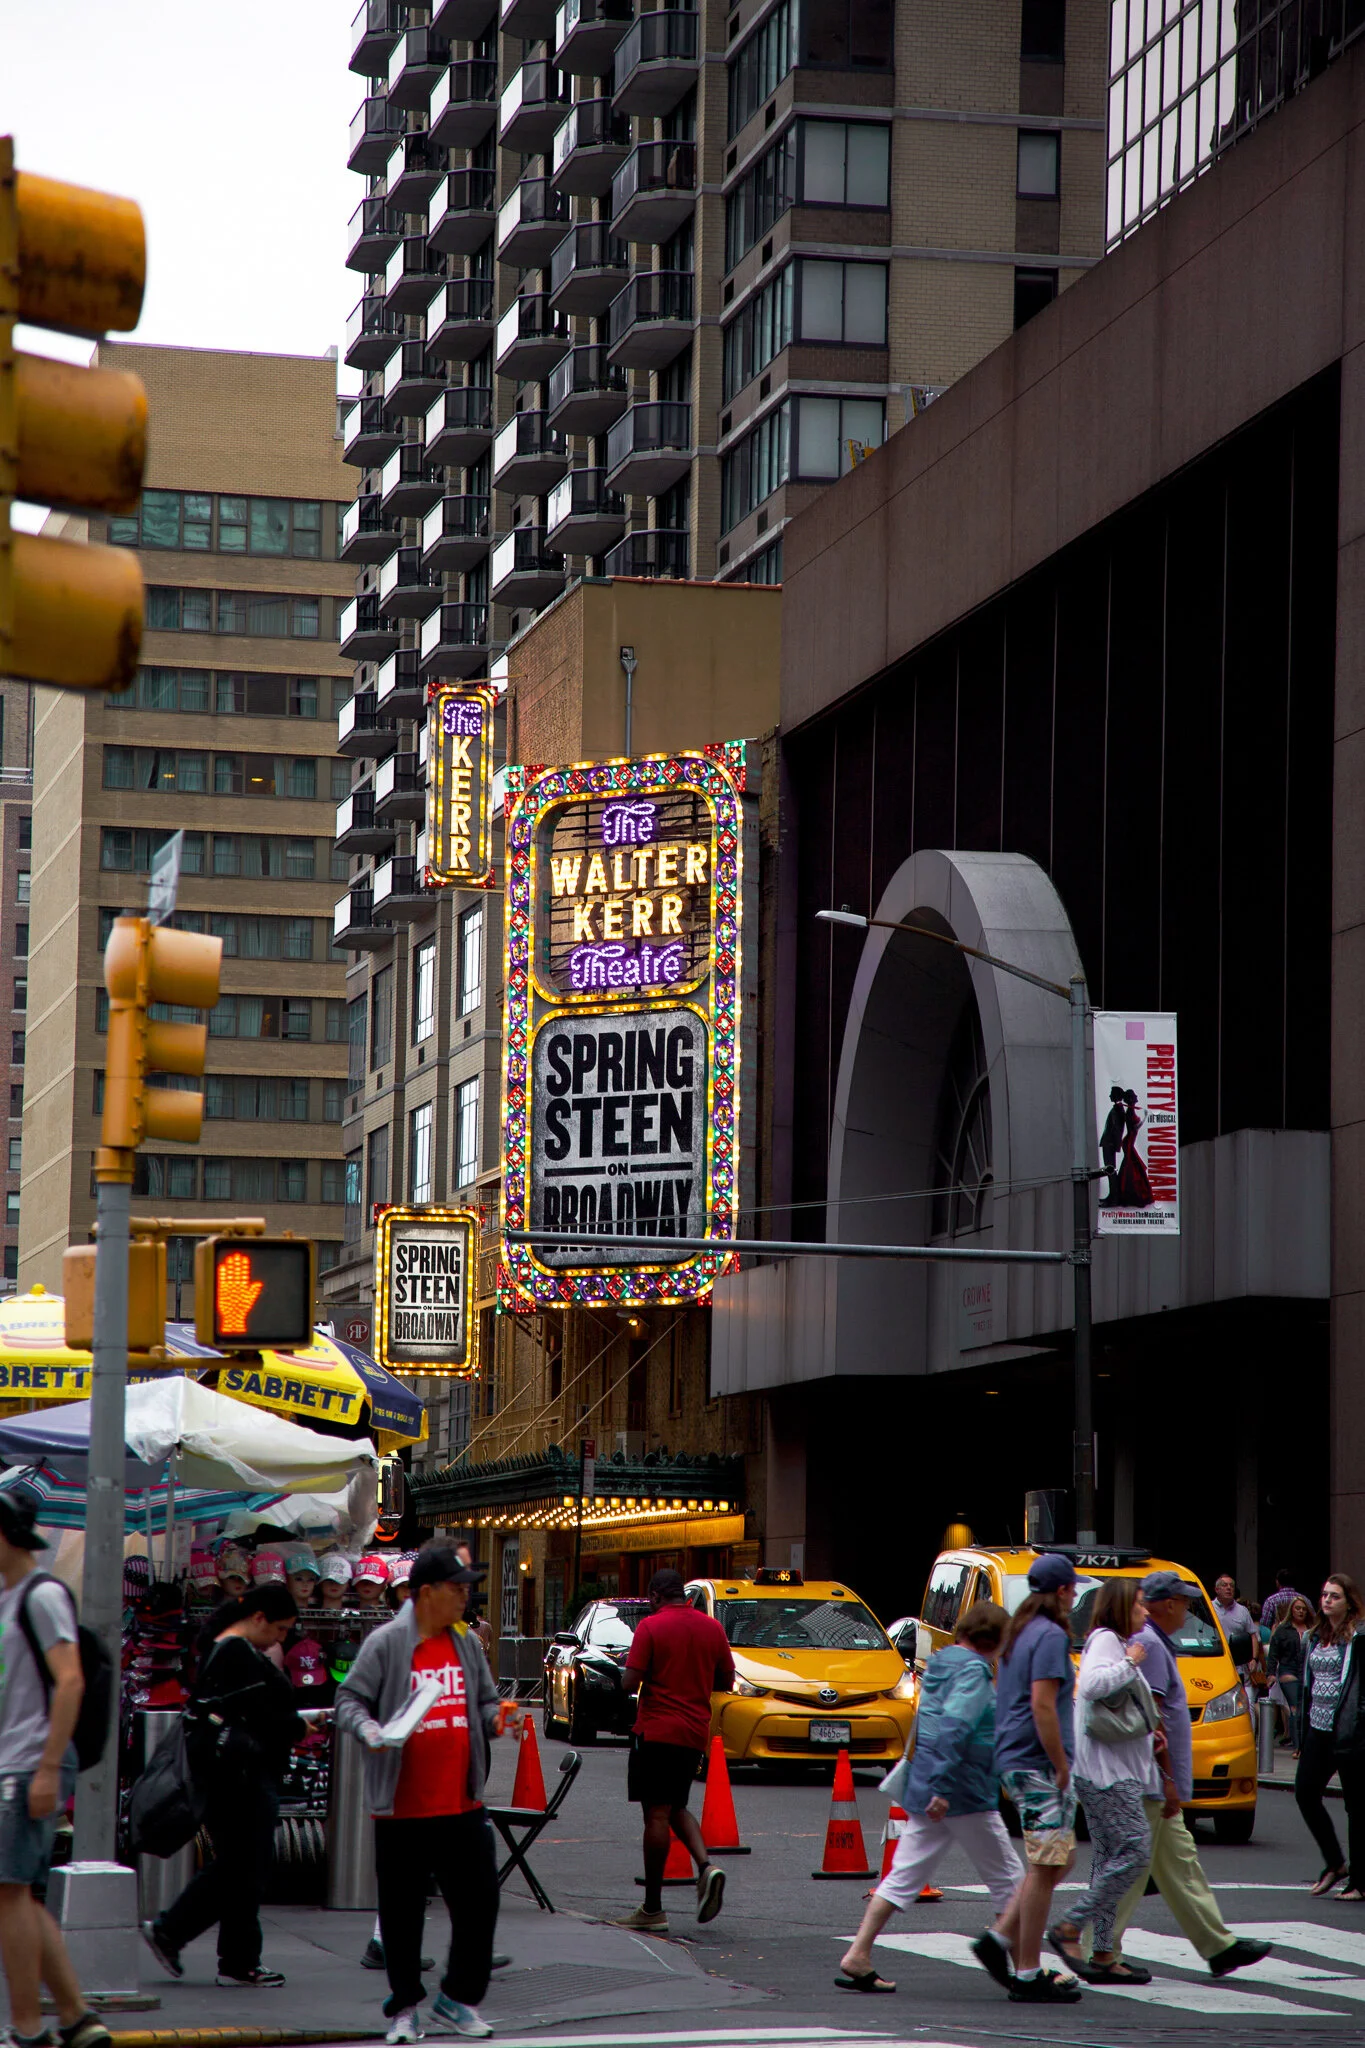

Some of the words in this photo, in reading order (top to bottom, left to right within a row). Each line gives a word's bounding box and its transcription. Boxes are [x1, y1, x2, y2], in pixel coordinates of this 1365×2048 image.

[443, 702, 482, 735] The
[449, 735, 473, 871] KERR
[602, 802, 656, 845] The
[550, 844, 709, 897] WALTER
[573, 893, 684, 942] KERR
[570, 943, 687, 989] Theatre
[545, 1025, 694, 1097] SPRING
[1146, 1043, 1176, 1113] PRETTY
[544, 1091, 693, 1161] STEEN
[607, 1162, 628, 1176] ON
[1147, 1125, 1177, 1202] WOMAN
[543, 1178, 693, 1254] BROADWAY
[395, 1244, 461, 1274] SPRING
[395, 1274, 460, 1304] STEEN
[963, 1283, 991, 1308] CROWNE
[395, 1311, 460, 1341] BROADWAY
[225, 1369, 357, 1415] SABRETT
[1076, 1554, 1120, 1568] 7K71
